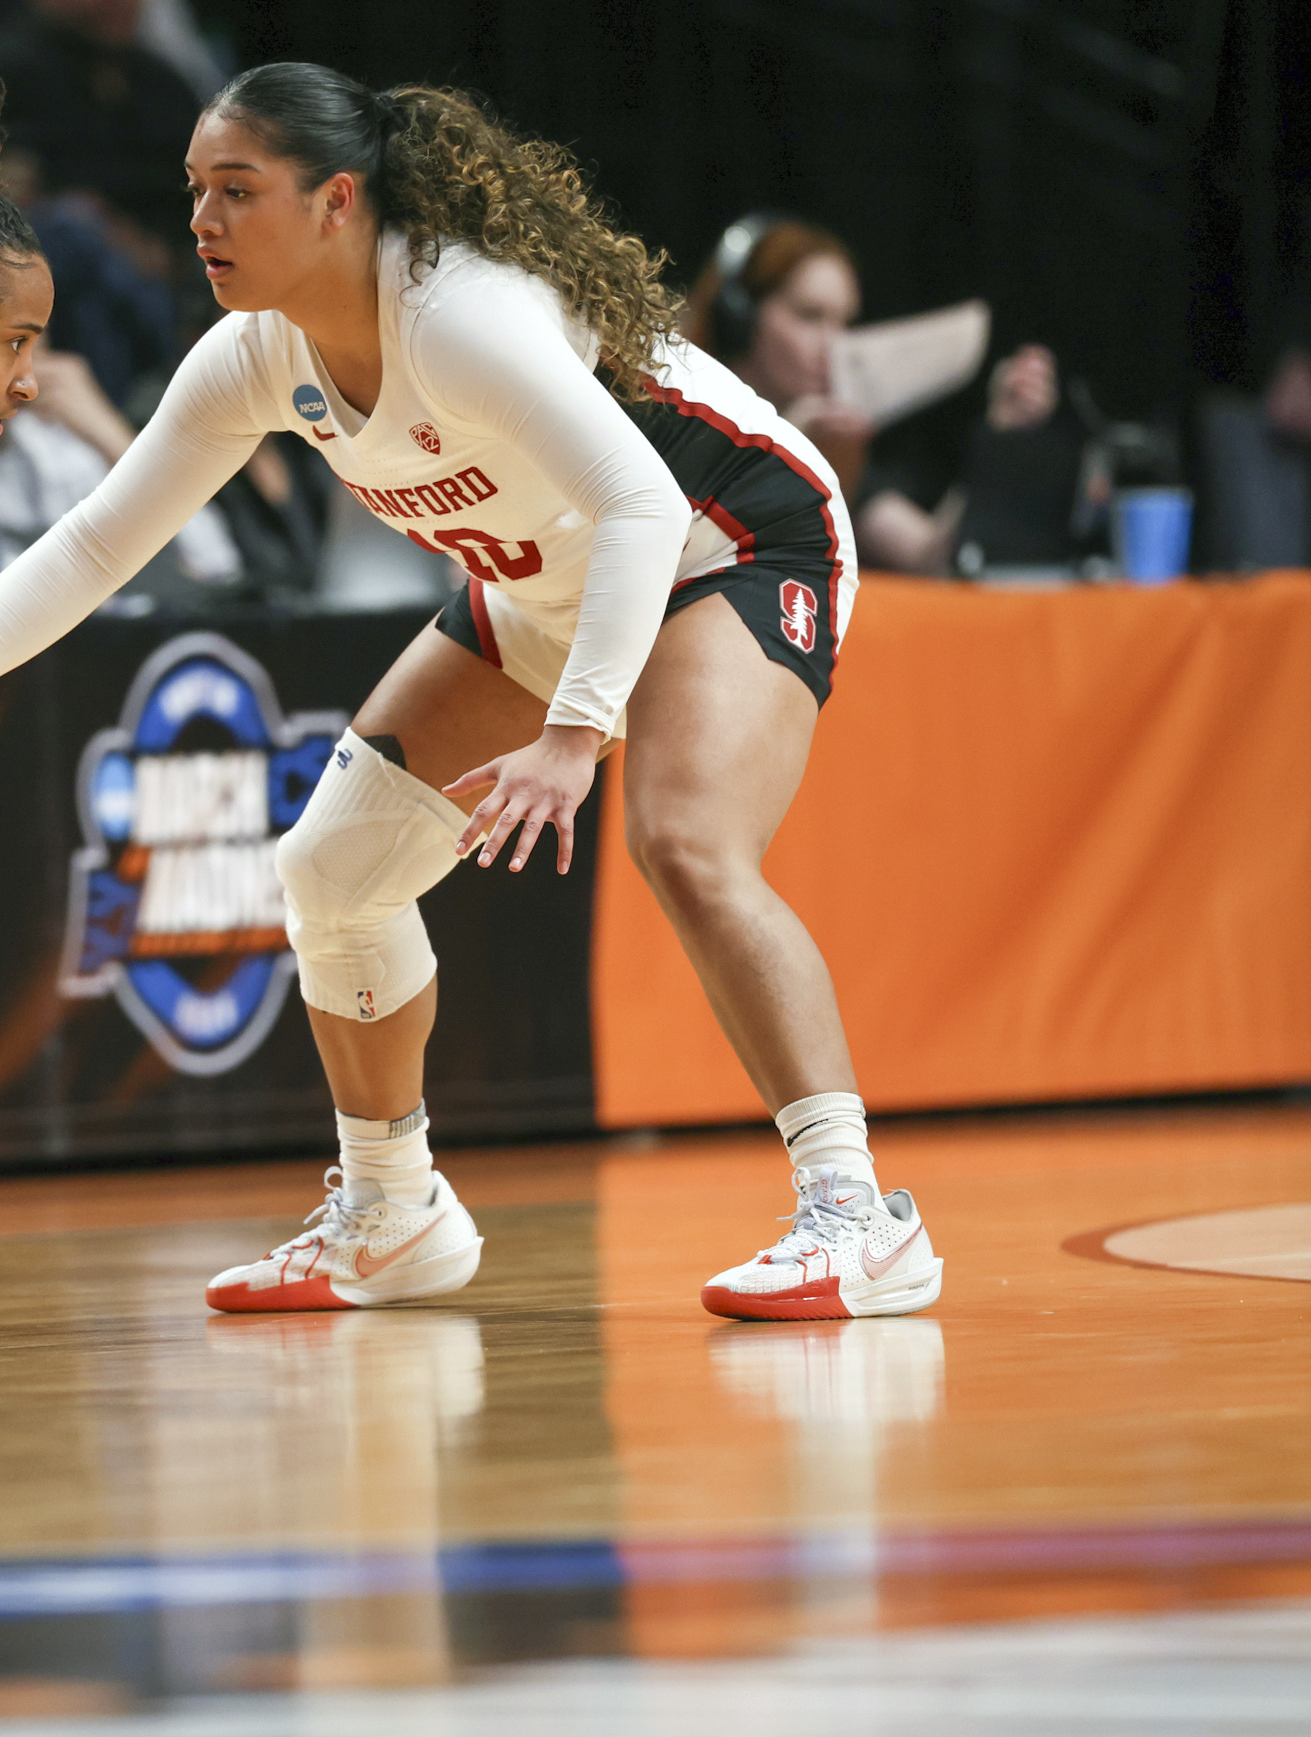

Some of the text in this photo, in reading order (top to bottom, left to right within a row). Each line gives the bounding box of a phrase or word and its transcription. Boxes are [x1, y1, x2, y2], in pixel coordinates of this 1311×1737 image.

[298, 401, 325, 414] NCAA
[410, 422, 439, 444] PAC
[421, 436, 439, 451] 12
